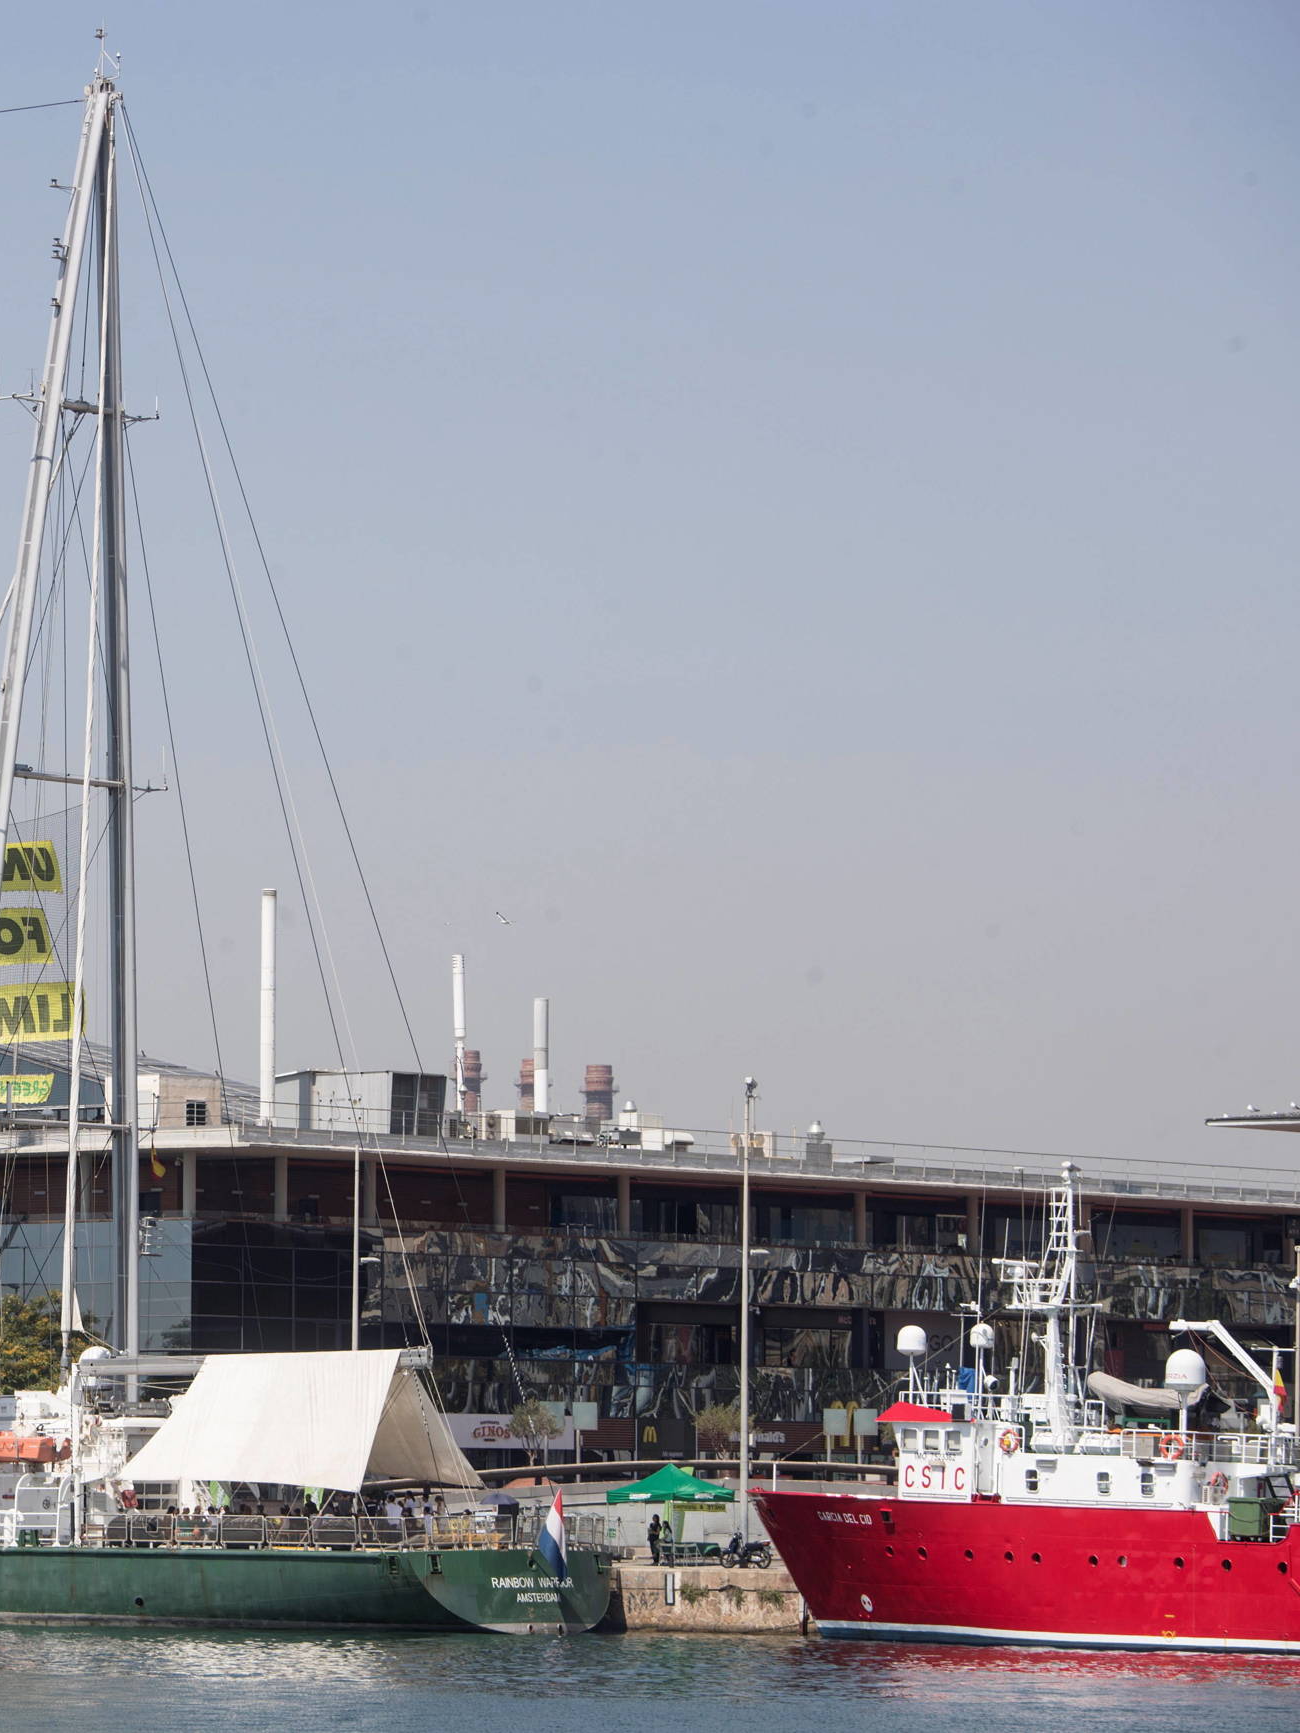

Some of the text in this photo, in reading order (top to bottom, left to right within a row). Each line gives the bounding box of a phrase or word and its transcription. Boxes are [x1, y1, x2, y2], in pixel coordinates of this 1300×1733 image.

[905, 1465, 965, 1490] CSIC
[843, 1513, 858, 1524] DEL
[491, 1577, 534, 1588] RAINBOW
[516, 1592, 561, 1603] AMSTERDAM
